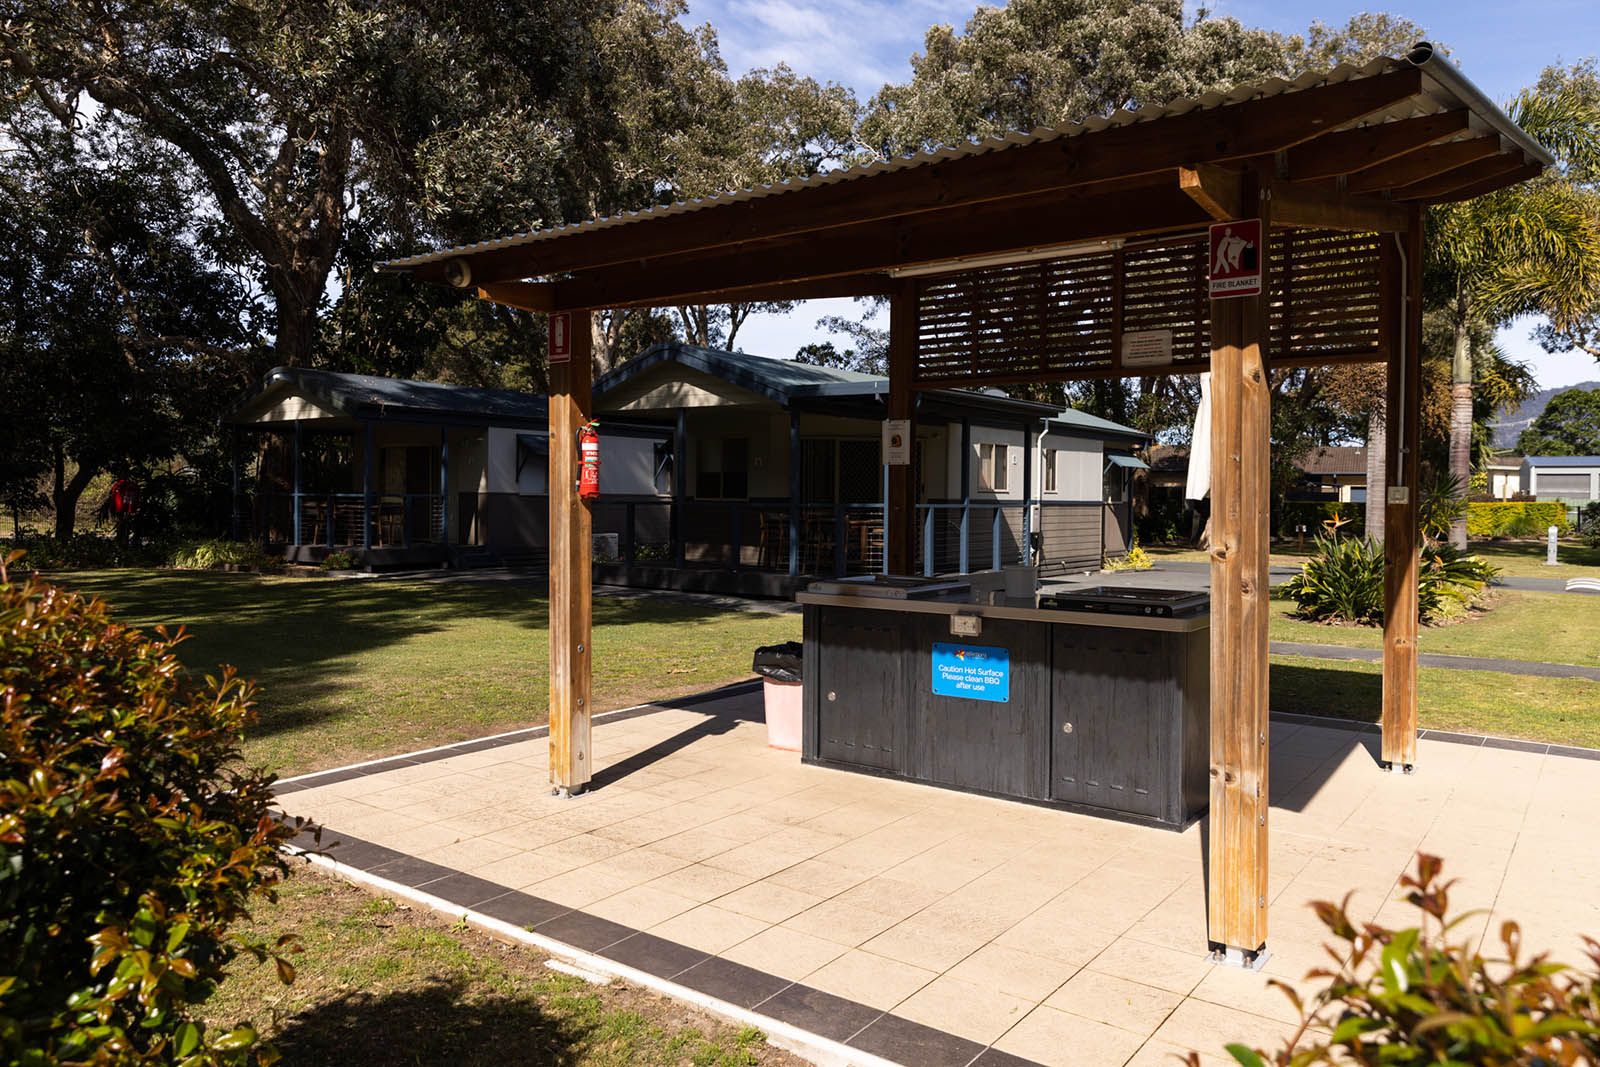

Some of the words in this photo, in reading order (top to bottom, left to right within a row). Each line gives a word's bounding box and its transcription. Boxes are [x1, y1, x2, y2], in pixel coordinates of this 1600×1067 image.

[1212, 281, 1227, 289] FIRE
[1227, 278, 1257, 288] BLANKET
[938, 664, 964, 673] Caution
[964, 666, 977, 675] Hot
[977, 667, 1004, 678] Surface
[942, 671, 964, 681] Please
[965, 674, 984, 683] clean
[984, 676, 1000, 685] BBQ
[955, 681, 972, 690] after
